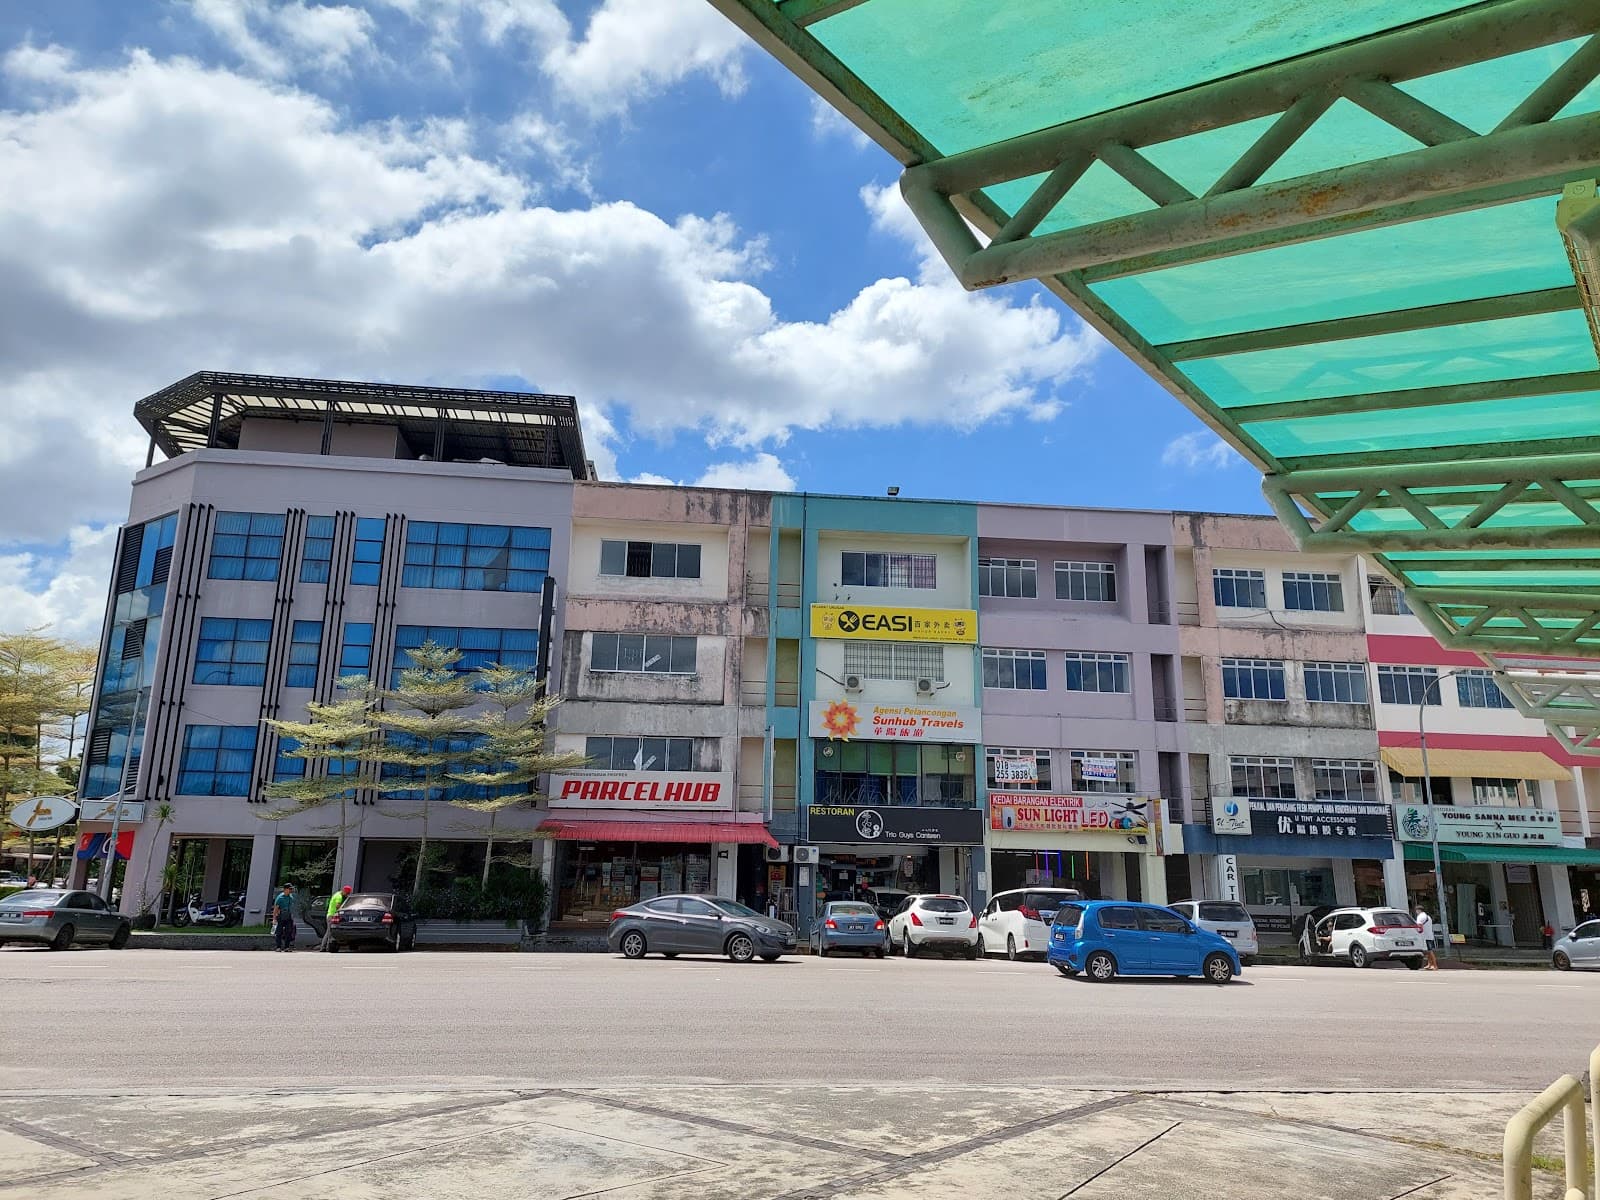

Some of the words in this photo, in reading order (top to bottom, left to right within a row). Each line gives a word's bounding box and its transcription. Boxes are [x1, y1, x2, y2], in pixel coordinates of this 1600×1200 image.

[862, 614, 912, 632] EASI
[873, 706, 901, 715] Agensi
[904, 707, 957, 718] Pelancongan
[873, 716, 917, 726] Sunhub
[921, 718, 964, 728] Travels
[996, 770, 1009, 779] 255
[560, 780, 721, 802] PARCELHUB
[992, 796, 1012, 805] KEDAI
[1013, 797, 1048, 806] BARANGAN
[1051, 798, 1081, 807] ELEKTRIK
[809, 806, 855, 816] RESTORAN
[1017, 808, 1040, 821] SUN
[1045, 809, 1078, 823] LIGHT
[1081, 810, 1109, 828] LED
[1301, 815, 1313, 823] TINT
[1316, 816, 1357, 824] ACCESSORIES
[1475, 813, 1505, 821] SANNA
[898, 831, 914, 839] Guys
[1456, 830, 1484, 838] YOUNG
[1486, 831, 1502, 839] XIN
[1225, 857, 1235, 881] CAR
